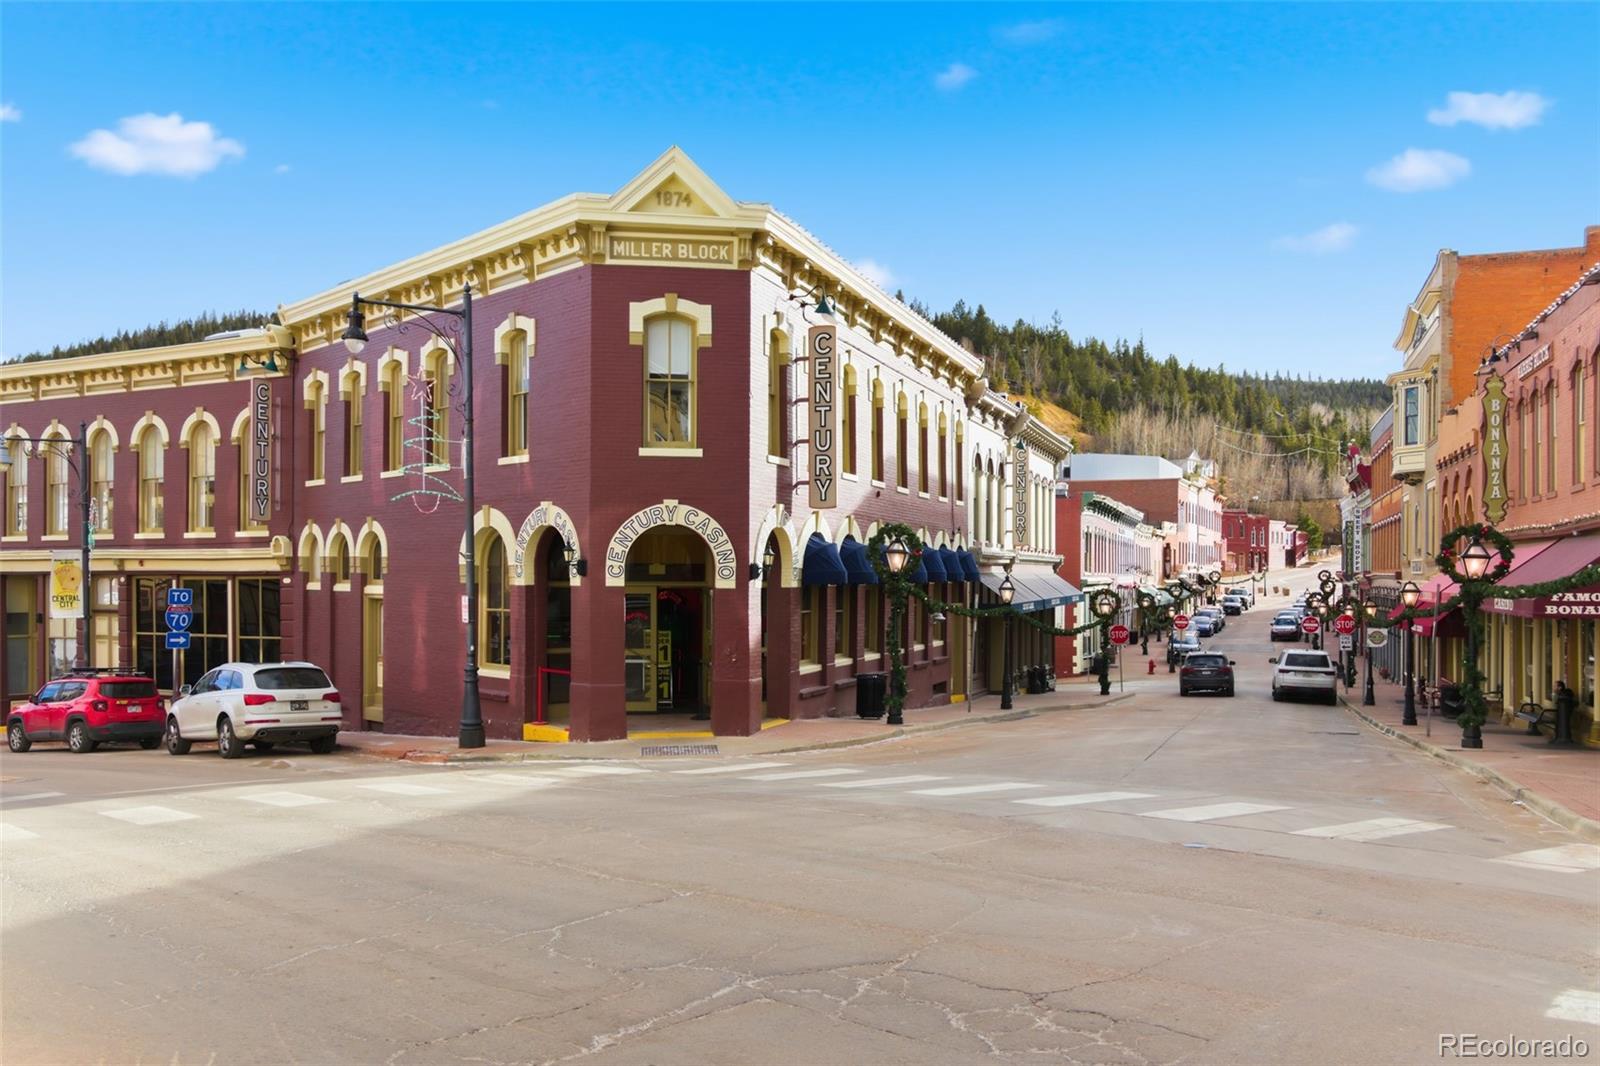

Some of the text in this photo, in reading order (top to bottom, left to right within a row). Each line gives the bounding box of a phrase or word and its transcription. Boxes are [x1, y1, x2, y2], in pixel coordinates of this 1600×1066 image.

[656, 191, 691, 207] 1874
[613, 241, 728, 260] MILLER BLOCK
[814, 332, 832, 502] CENTURY
[256, 384, 269, 515] CENTURY
[1490, 399, 1501, 498] BONANZA
[1015, 449, 1026, 542] CENTURY
[607, 505, 677, 578] CENTURY
[684, 509, 735, 580] CASINO
[172, 592, 189, 602] TO
[170, 614, 189, 627] 70
[1336, 621, 1355, 629] STOP
[1111, 630, 1128, 639] STOP
